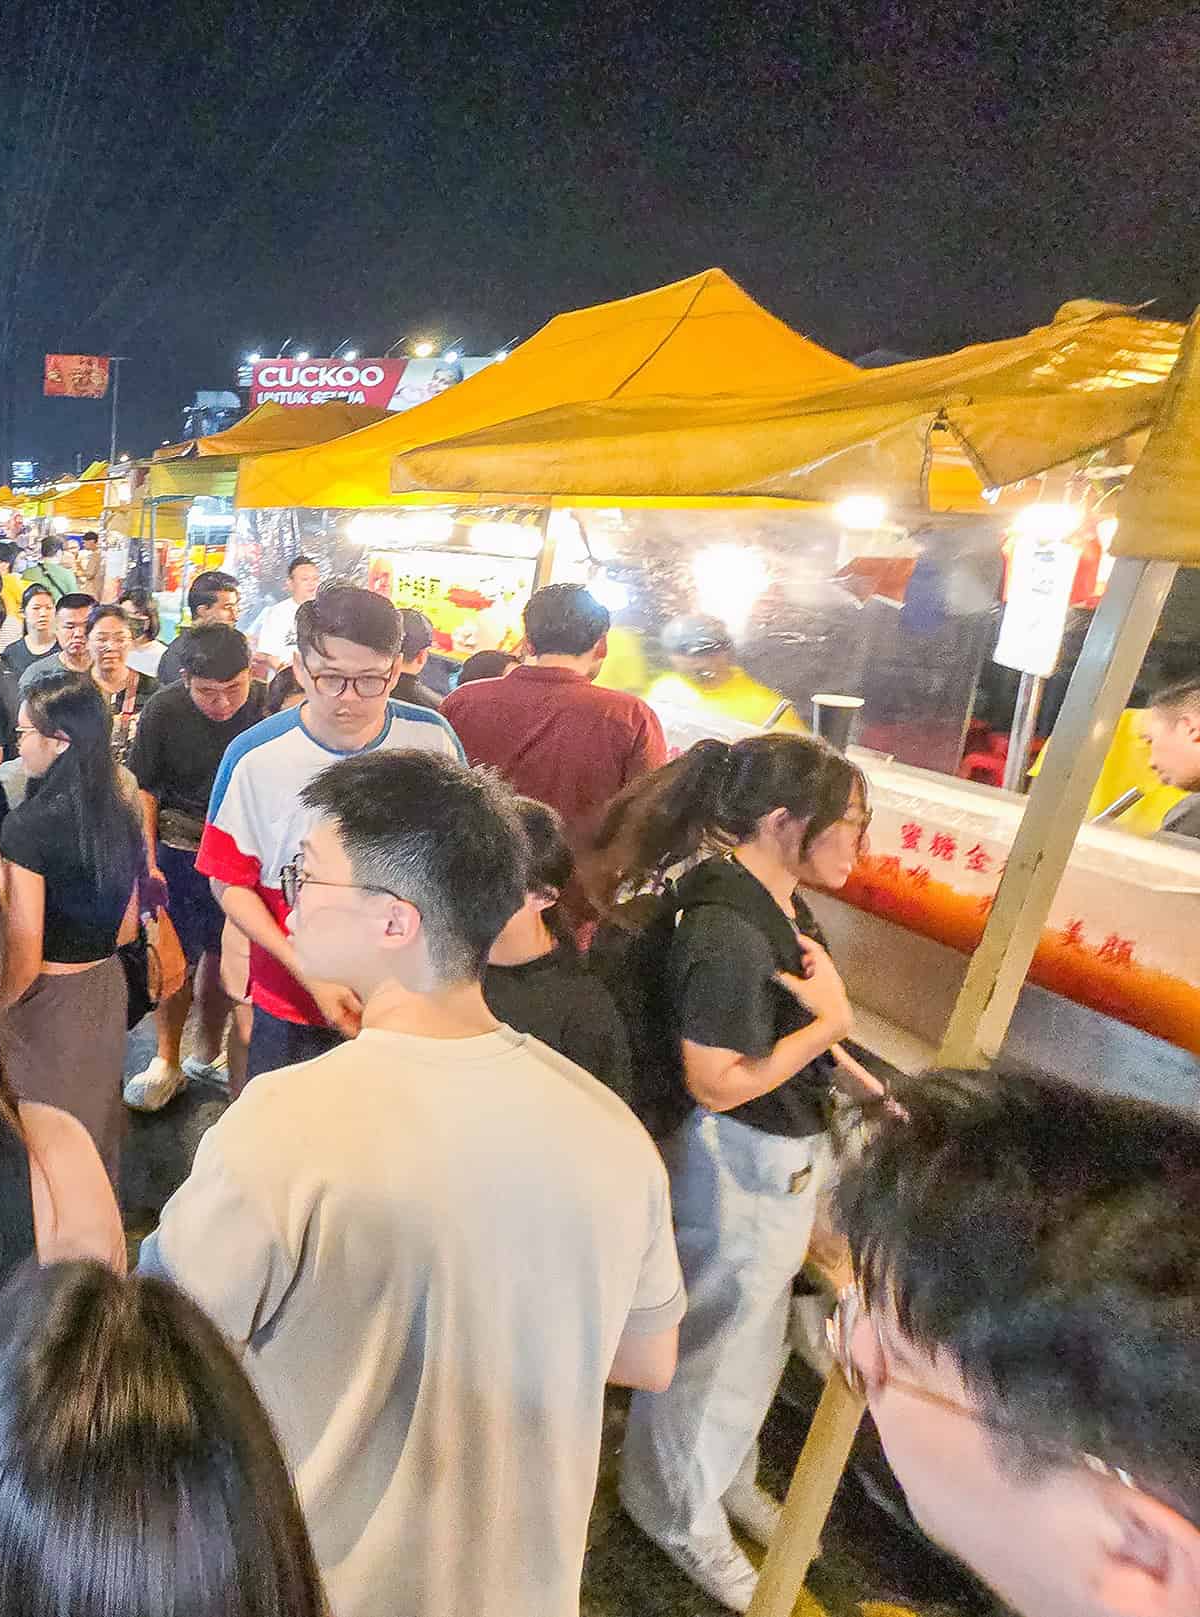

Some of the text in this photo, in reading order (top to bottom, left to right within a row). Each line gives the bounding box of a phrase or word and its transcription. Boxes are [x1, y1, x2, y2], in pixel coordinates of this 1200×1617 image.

[257, 366, 385, 388] CUCKOO
[256, 390, 311, 405] UNTUK
[900, 821, 1006, 874] 蜜糖金
